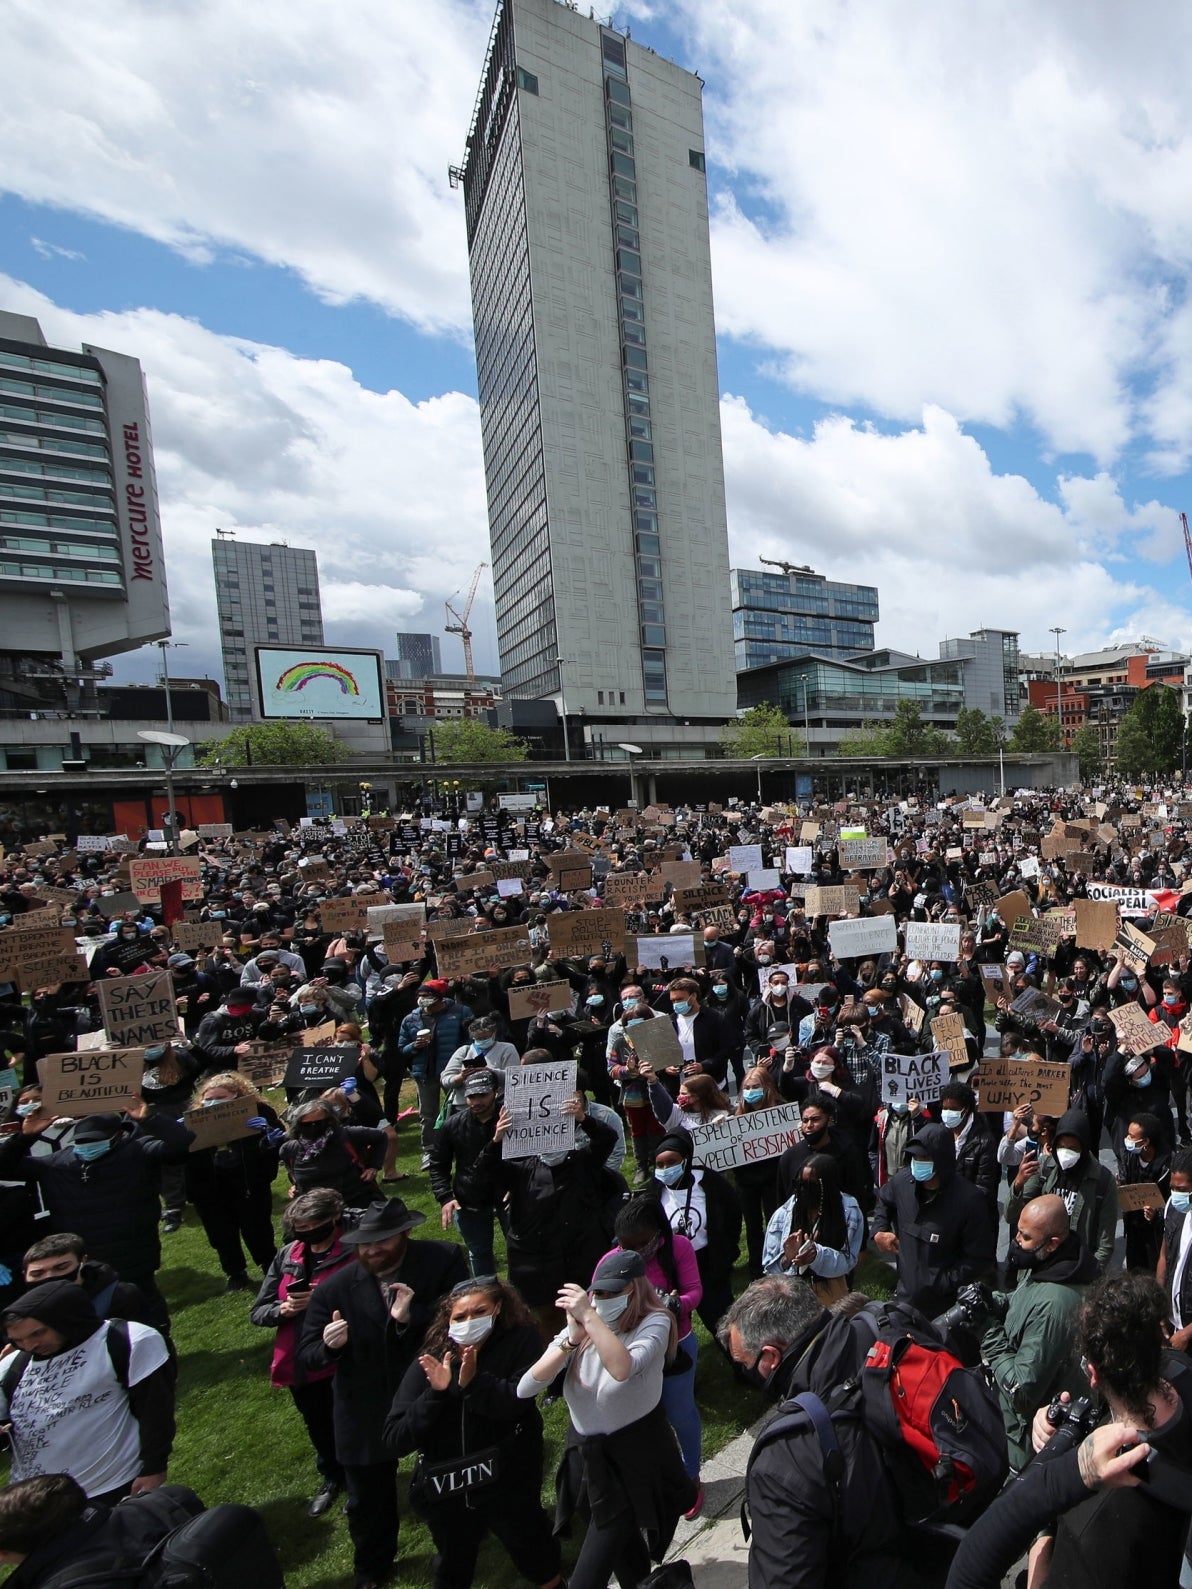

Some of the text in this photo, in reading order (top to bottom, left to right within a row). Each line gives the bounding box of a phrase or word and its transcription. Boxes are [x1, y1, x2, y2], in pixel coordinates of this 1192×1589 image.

[122, 421, 143, 479] HOTEL
[132, 859, 181, 871] CAN WE
[845, 854, 881, 863] BETRAYAL
[607, 876, 655, 886] COUNTER
[606, 884, 648, 894] RACISM
[683, 885, 725, 899] SILENCE
[702, 904, 732, 923] BLACK
[576, 918, 604, 928] STOP
[909, 925, 956, 934] CONFRONT THE
[20, 931, 65, 943] BREATHE
[855, 928, 892, 942] SILENCE
[907, 935, 958, 945] CULTURE POWER
[19, 941, 61, 950] BREATHE
[555, 944, 593, 957] #BLM
[915, 943, 942, 951] WITH THE
[907, 951, 926, 960] POWER
[23, 956, 81, 974] SILENCE
[110, 981, 158, 1005] SAY
[107, 1000, 171, 1023] THEIR
[934, 1020, 947, 1029] THE
[110, 1020, 178, 1046] NAMES
[942, 1029, 953, 1037] IS
[939, 1037, 961, 1050] NOT
[61, 1053, 129, 1073] BLACK
[302, 1054, 344, 1065] I CAN'T
[885, 1054, 941, 1076] BLACK
[300, 1066, 341, 1075] BREATHE
[981, 1062, 1066, 1078] In all DARKER
[79, 1073, 102, 1086] IS
[511, 1069, 568, 1086] SILENCE
[906, 1074, 941, 1091] LIVES
[1020, 1078, 1032, 1089] the
[58, 1085, 133, 1101] BEAUTIFUL
[528, 1095, 552, 1120] IS
[737, 1104, 801, 1135] EXISTENCE
[506, 1123, 567, 1140] VIOLENCE
[731, 1134, 743, 1145] OR
[743, 1128, 805, 1162] RESISTANCE
[79, 1390, 112, 1409] RICE
[431, 1459, 494, 1494] VLTN
